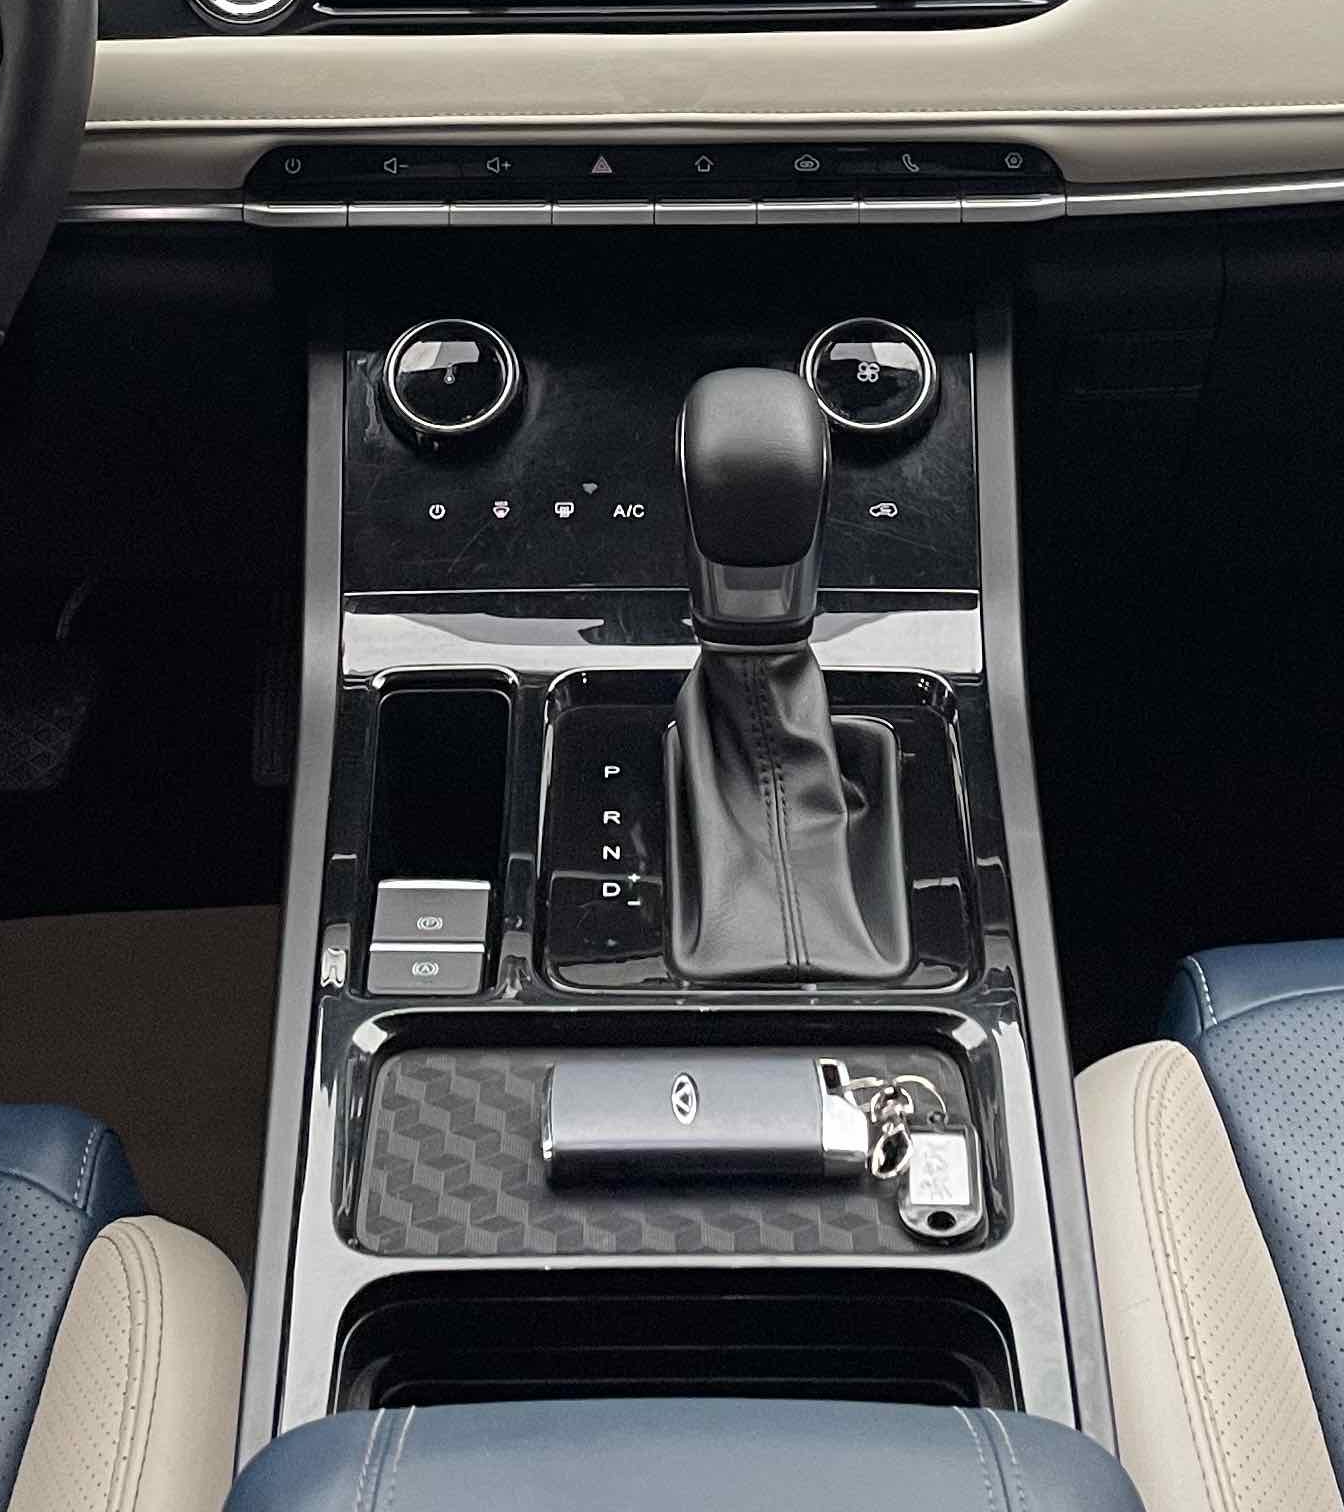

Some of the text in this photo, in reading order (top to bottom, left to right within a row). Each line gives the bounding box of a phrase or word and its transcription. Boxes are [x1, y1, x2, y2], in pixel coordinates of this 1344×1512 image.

[613, 504, 645, 518] A/C
[604, 765, 621, 778] P
[603, 810, 621, 825] R
[602, 845, 621, 860] N
[602, 882, 621, 897] D
